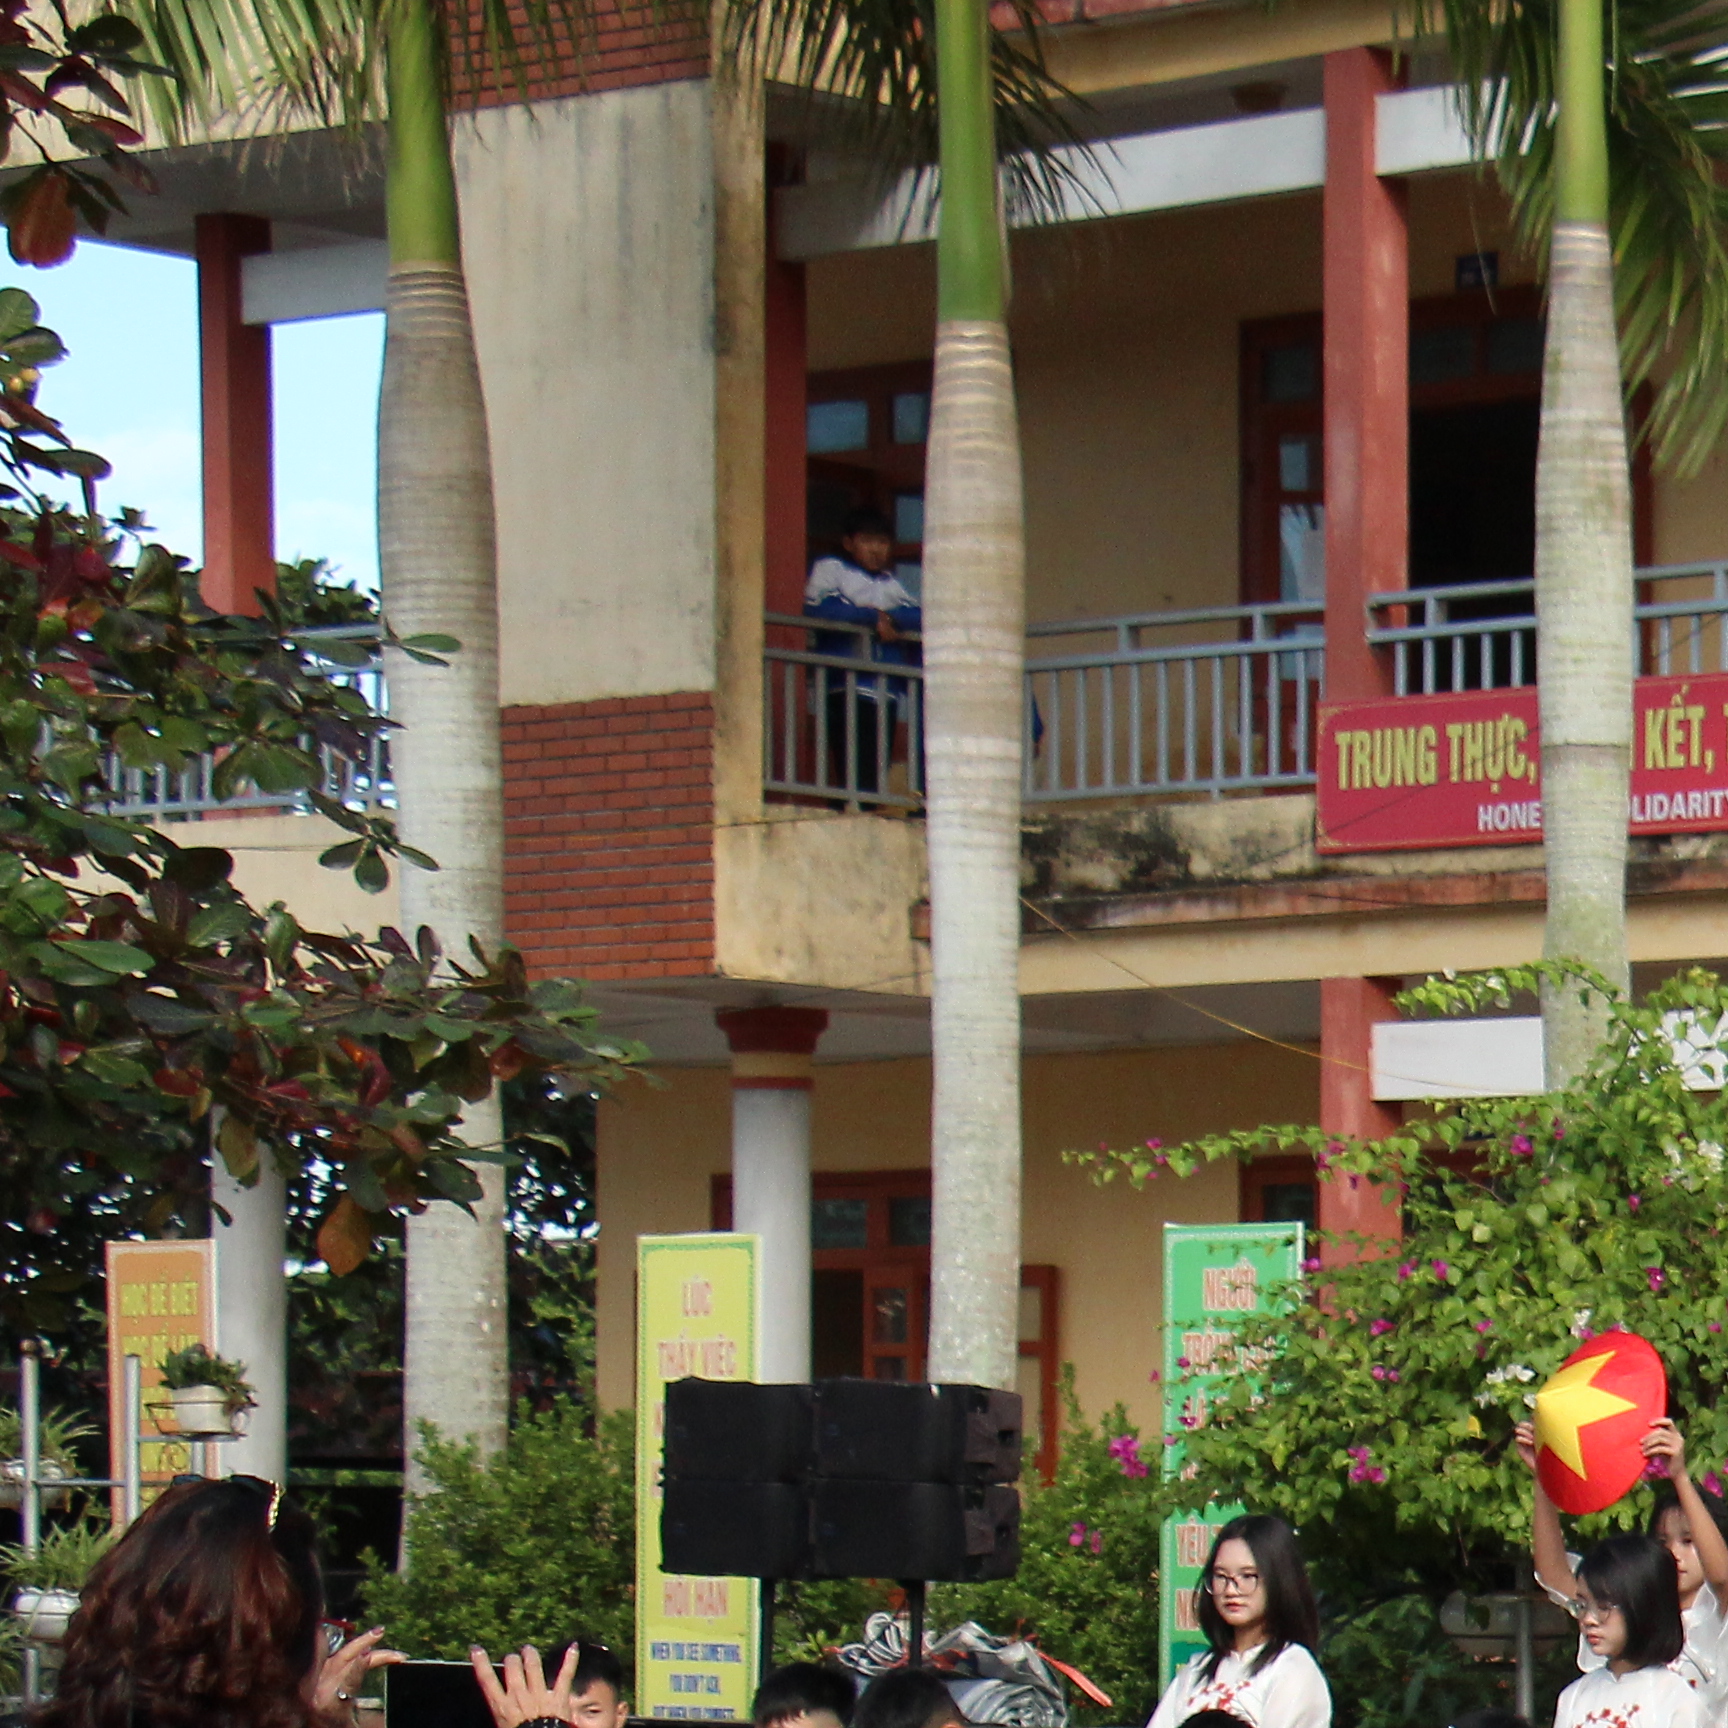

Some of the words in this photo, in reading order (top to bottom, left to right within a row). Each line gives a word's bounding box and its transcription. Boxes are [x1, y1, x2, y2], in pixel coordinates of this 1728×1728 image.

[1334, 724, 1440, 791] TRUNG
[1446, 713, 1538, 793] THỰC,
[1643, 683, 1715, 775] KẾT,
[1477, 800, 1541, 832] HONE
